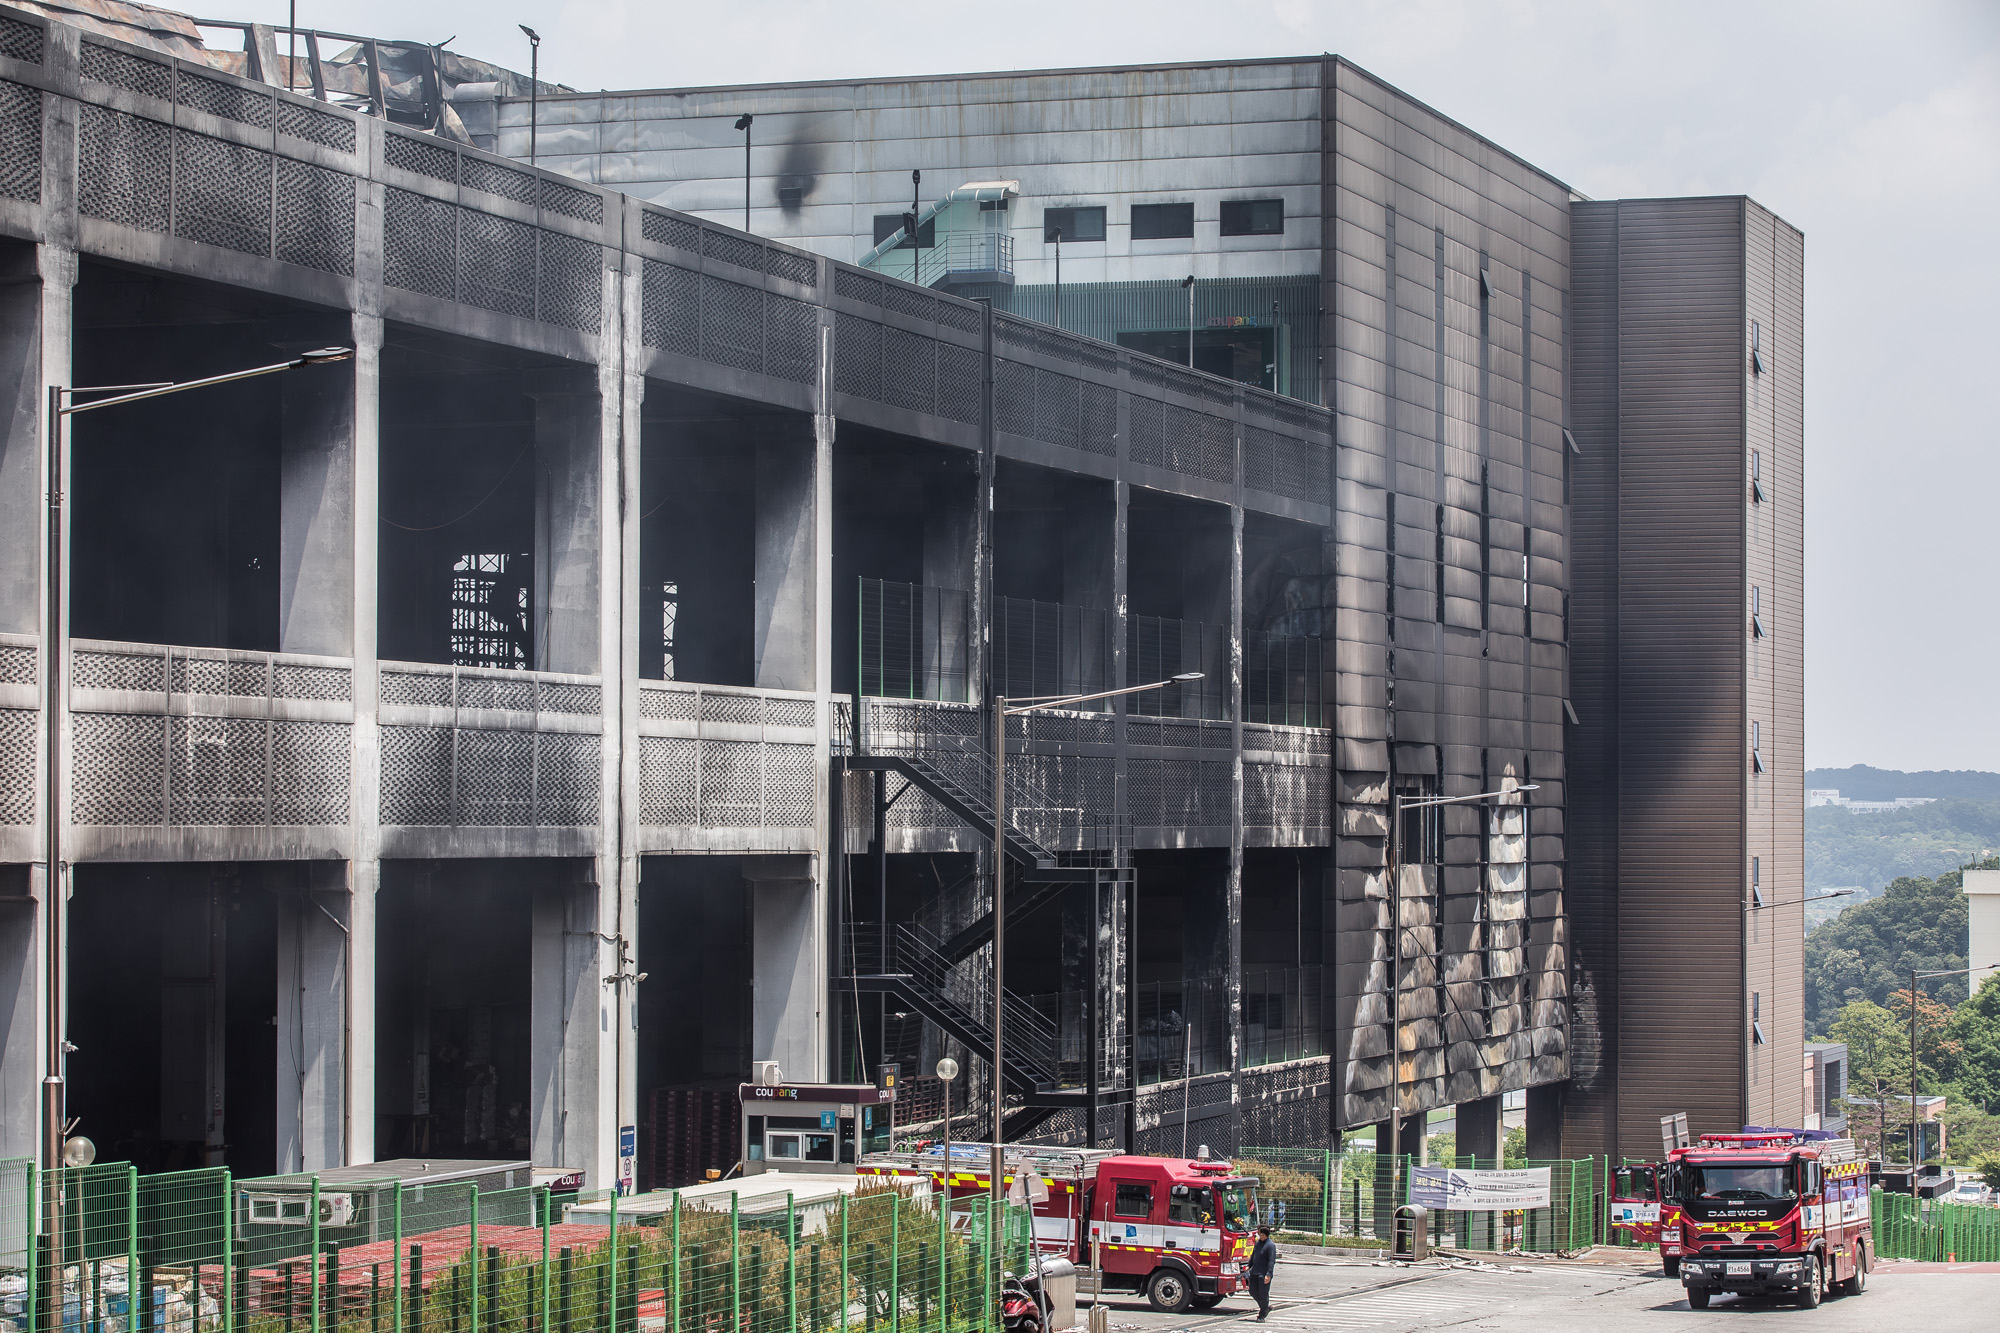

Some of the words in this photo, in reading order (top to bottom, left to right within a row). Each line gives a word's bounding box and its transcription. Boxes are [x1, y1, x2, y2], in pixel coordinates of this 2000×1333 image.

[1208, 316, 1257, 328] coupang
[755, 1087, 798, 1099] coupang
[1415, 1176, 1428, 1186] 보안
[1430, 1177, 1442, 1188] 공지
[1707, 1209, 1768, 1217] DAEWOO
[1716, 1222, 1760, 1232] 경기도소방
